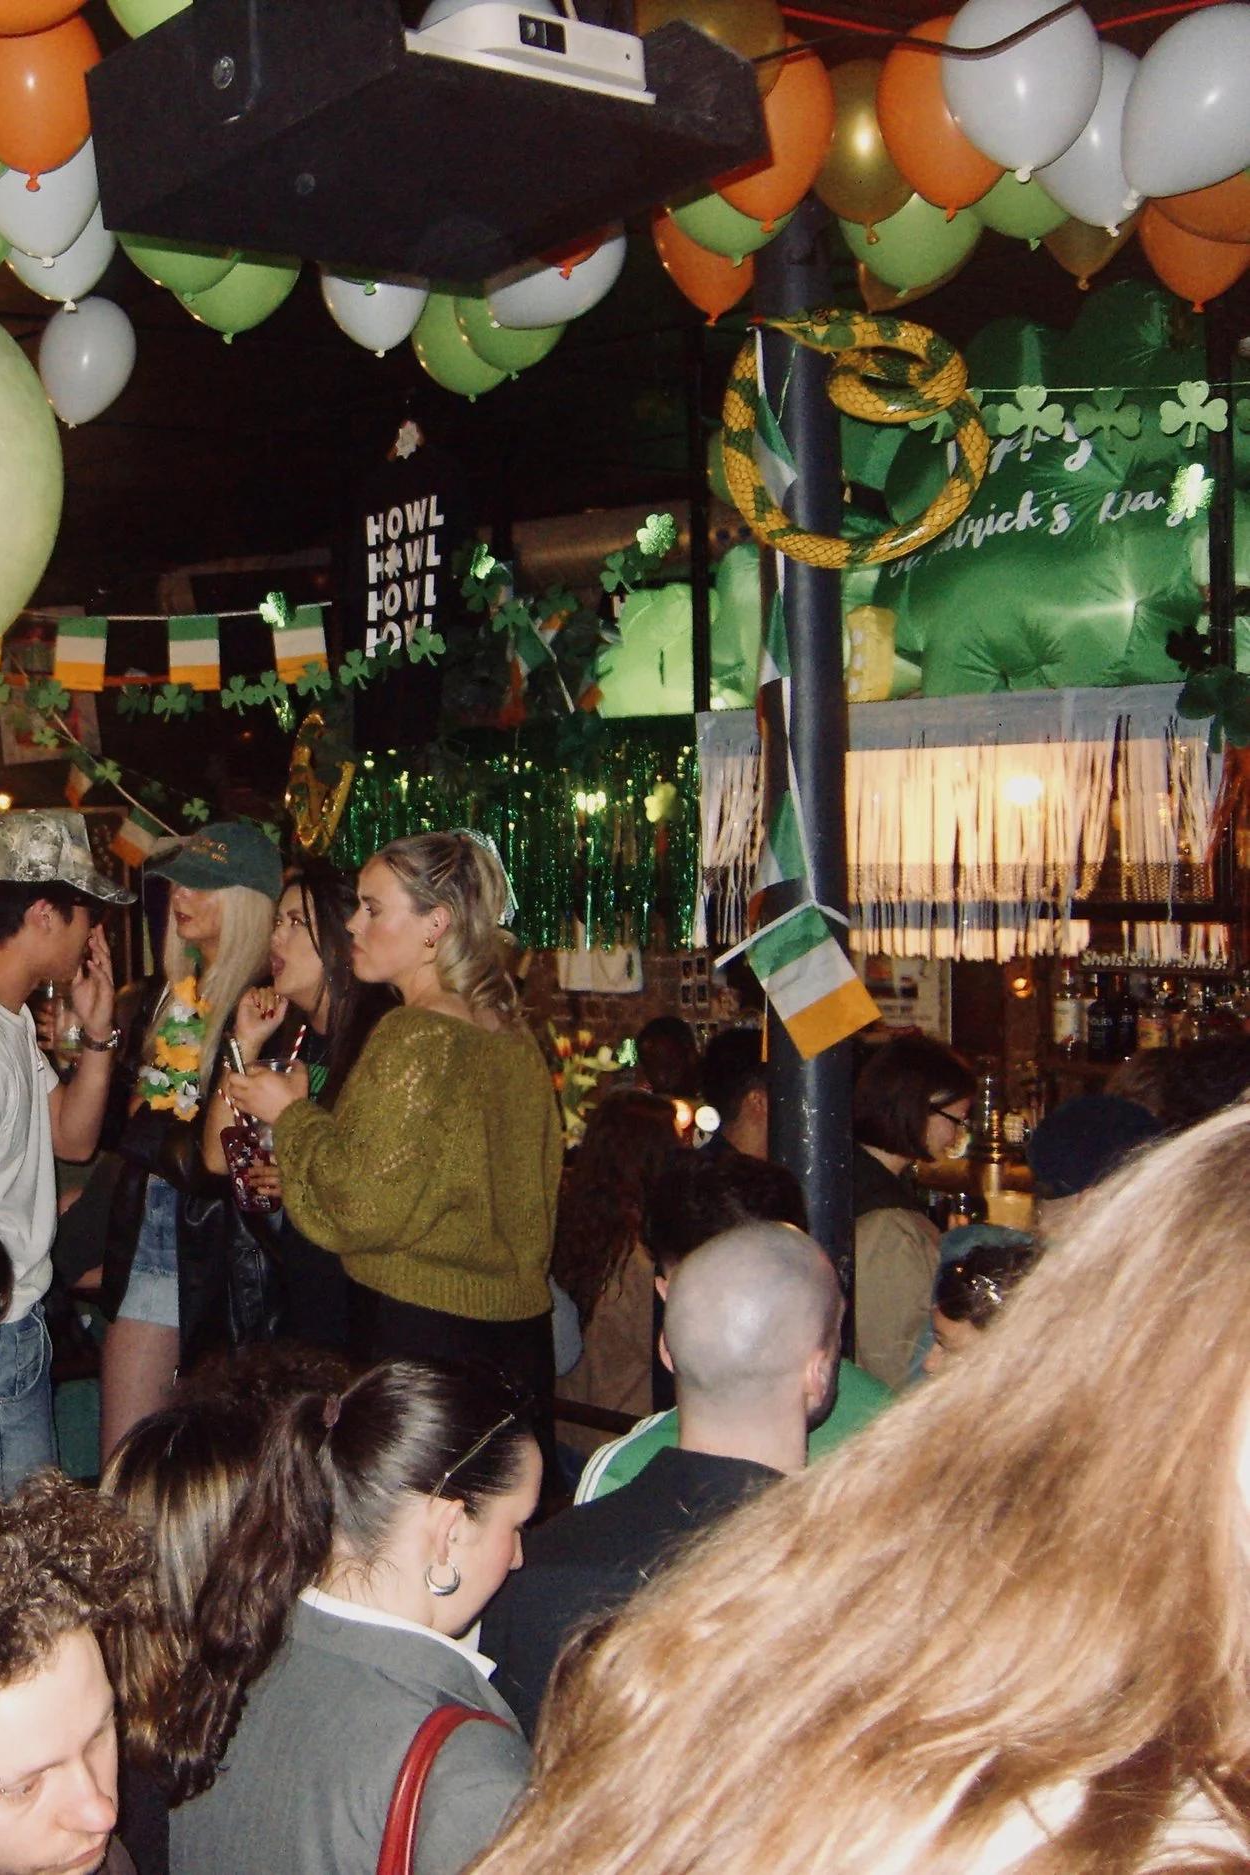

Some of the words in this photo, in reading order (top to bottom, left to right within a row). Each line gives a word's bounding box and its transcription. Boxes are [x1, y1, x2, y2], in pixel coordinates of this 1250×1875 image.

[366, 495, 444, 545] HOWL
[928, 489, 1077, 557] atrick's
[368, 534, 441, 584] HWL
